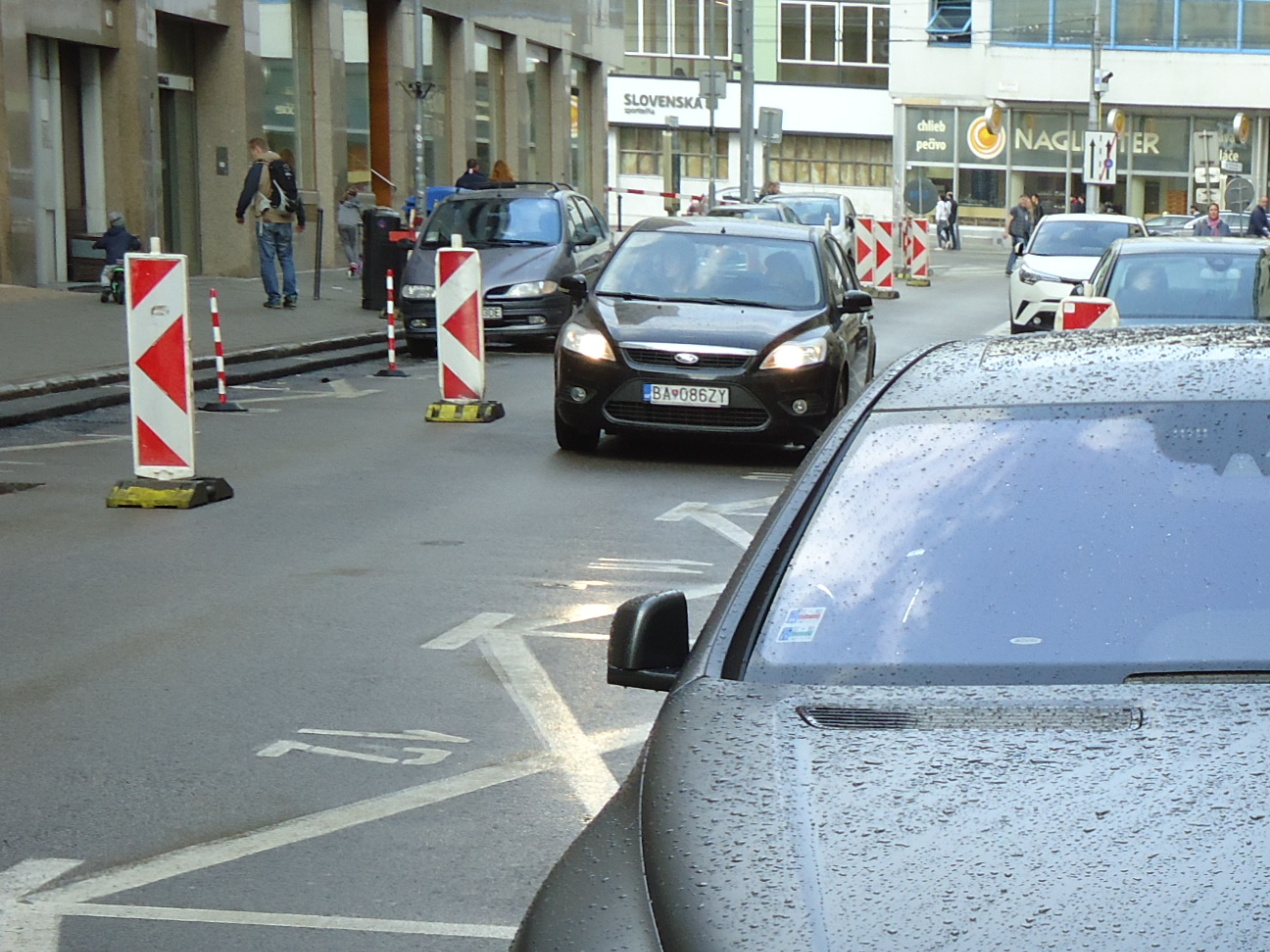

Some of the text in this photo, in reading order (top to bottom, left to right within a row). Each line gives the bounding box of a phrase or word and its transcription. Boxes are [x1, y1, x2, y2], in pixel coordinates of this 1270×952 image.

[917, 119, 946, 132] chlieb
[916, 138, 947, 152] pečivo
[652, 386, 726, 403] BA 086ZY
